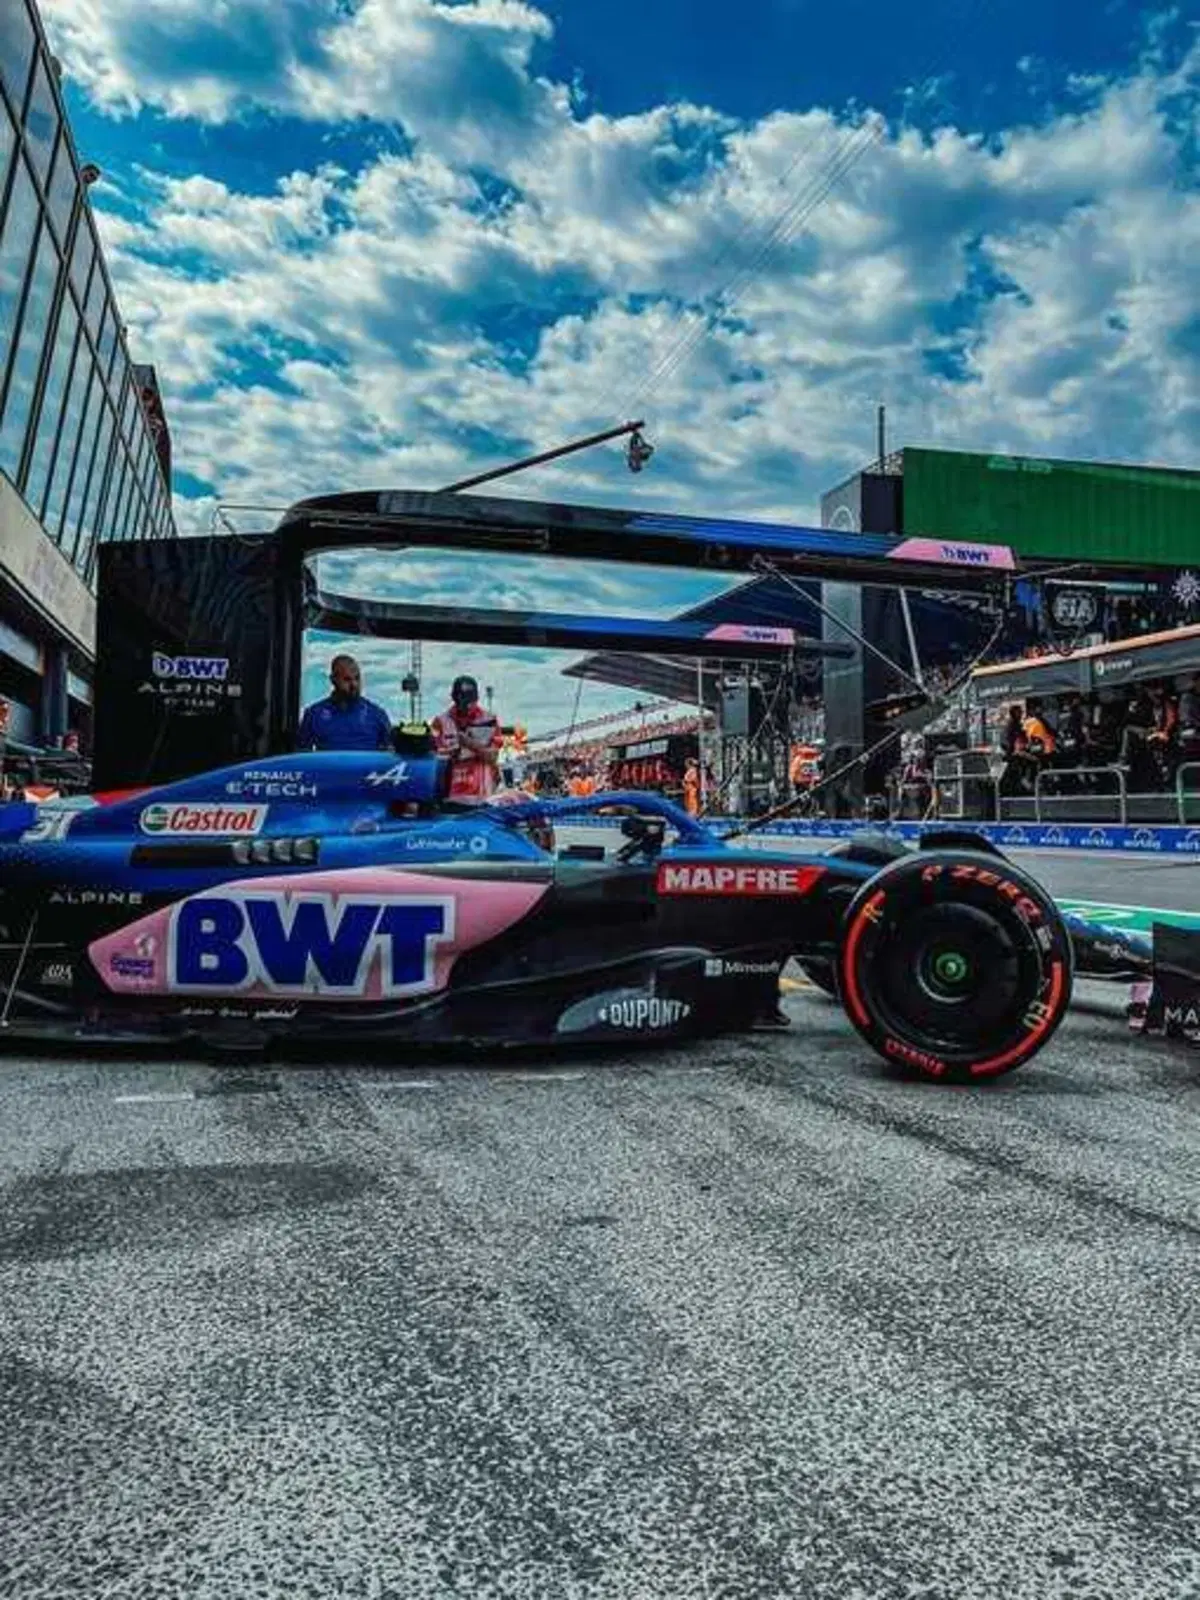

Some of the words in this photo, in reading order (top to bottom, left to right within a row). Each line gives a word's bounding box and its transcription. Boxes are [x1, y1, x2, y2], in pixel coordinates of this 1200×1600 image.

[176, 656, 229, 679] BWT
[170, 806, 258, 831] Castrol
[664, 866, 800, 892] MAPFRE
[48, 890, 143, 905] ALPINE
[175, 897, 446, 988] BWT
[610, 997, 683, 1029] DUPONT
